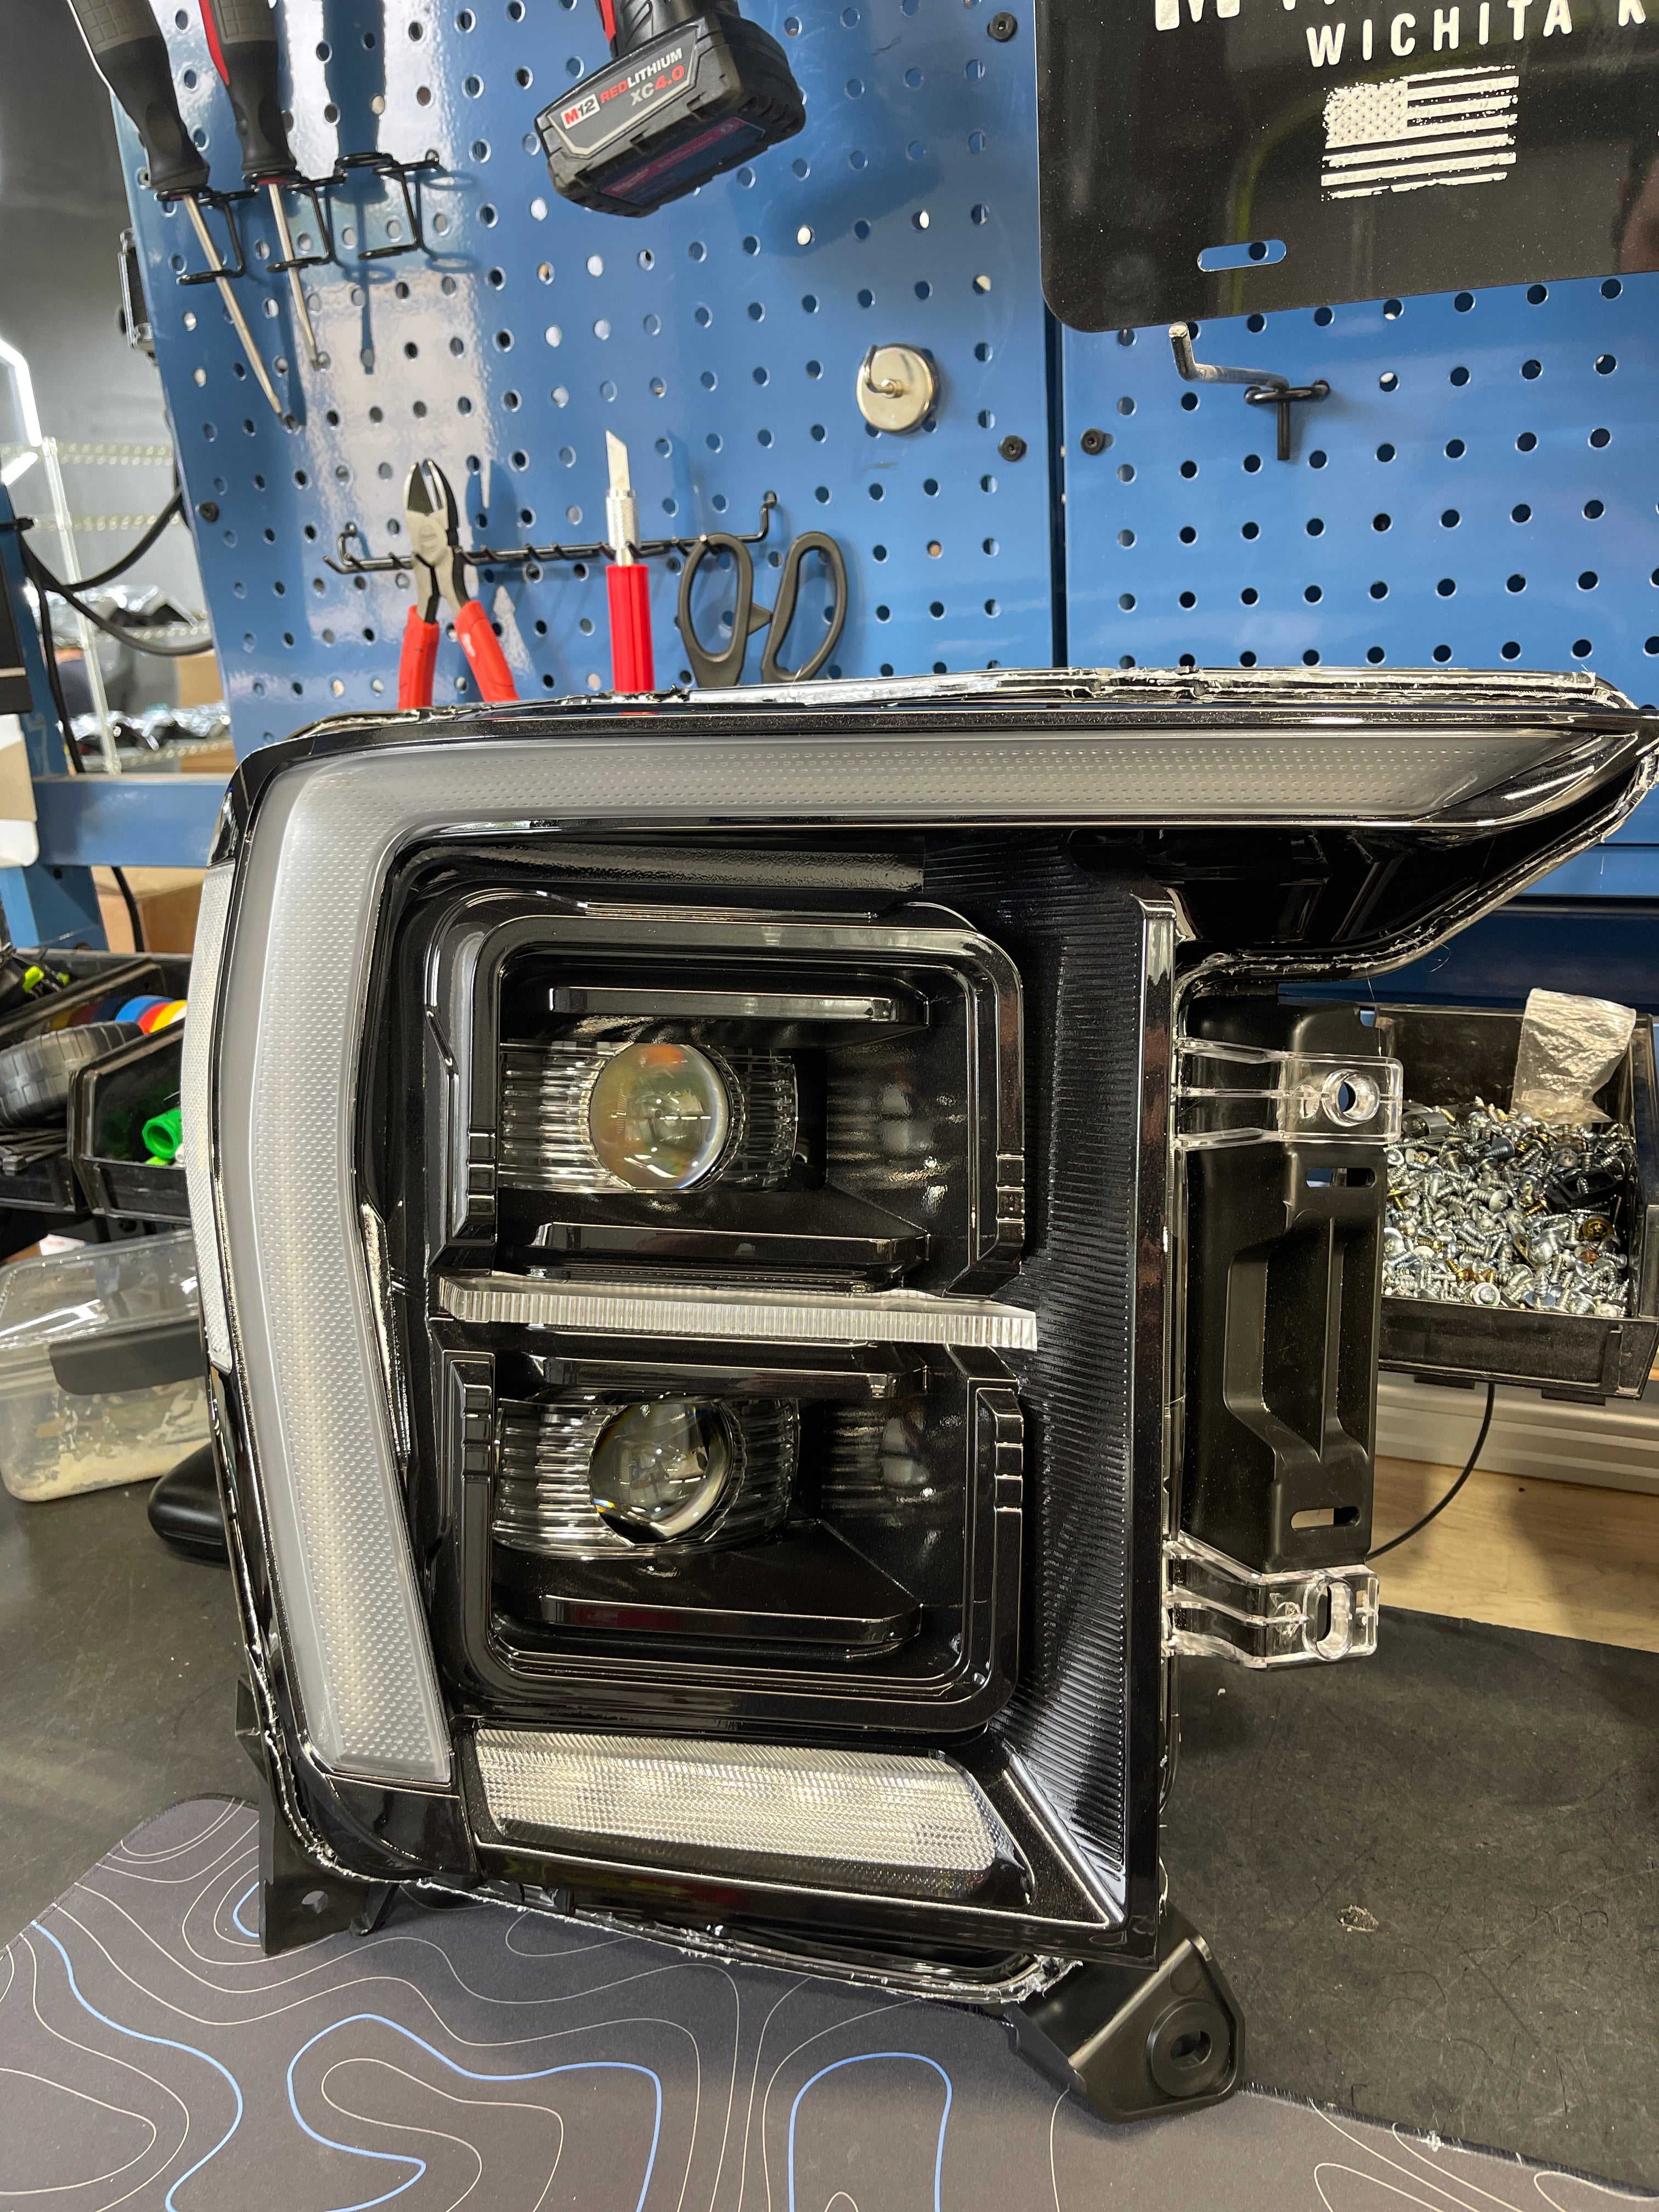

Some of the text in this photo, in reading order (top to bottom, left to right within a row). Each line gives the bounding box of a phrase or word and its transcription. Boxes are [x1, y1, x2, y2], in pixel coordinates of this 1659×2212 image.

[1306, 0, 1572, 67] WICHITA
[564, 48, 682, 125] M12 REDLITHIUM
